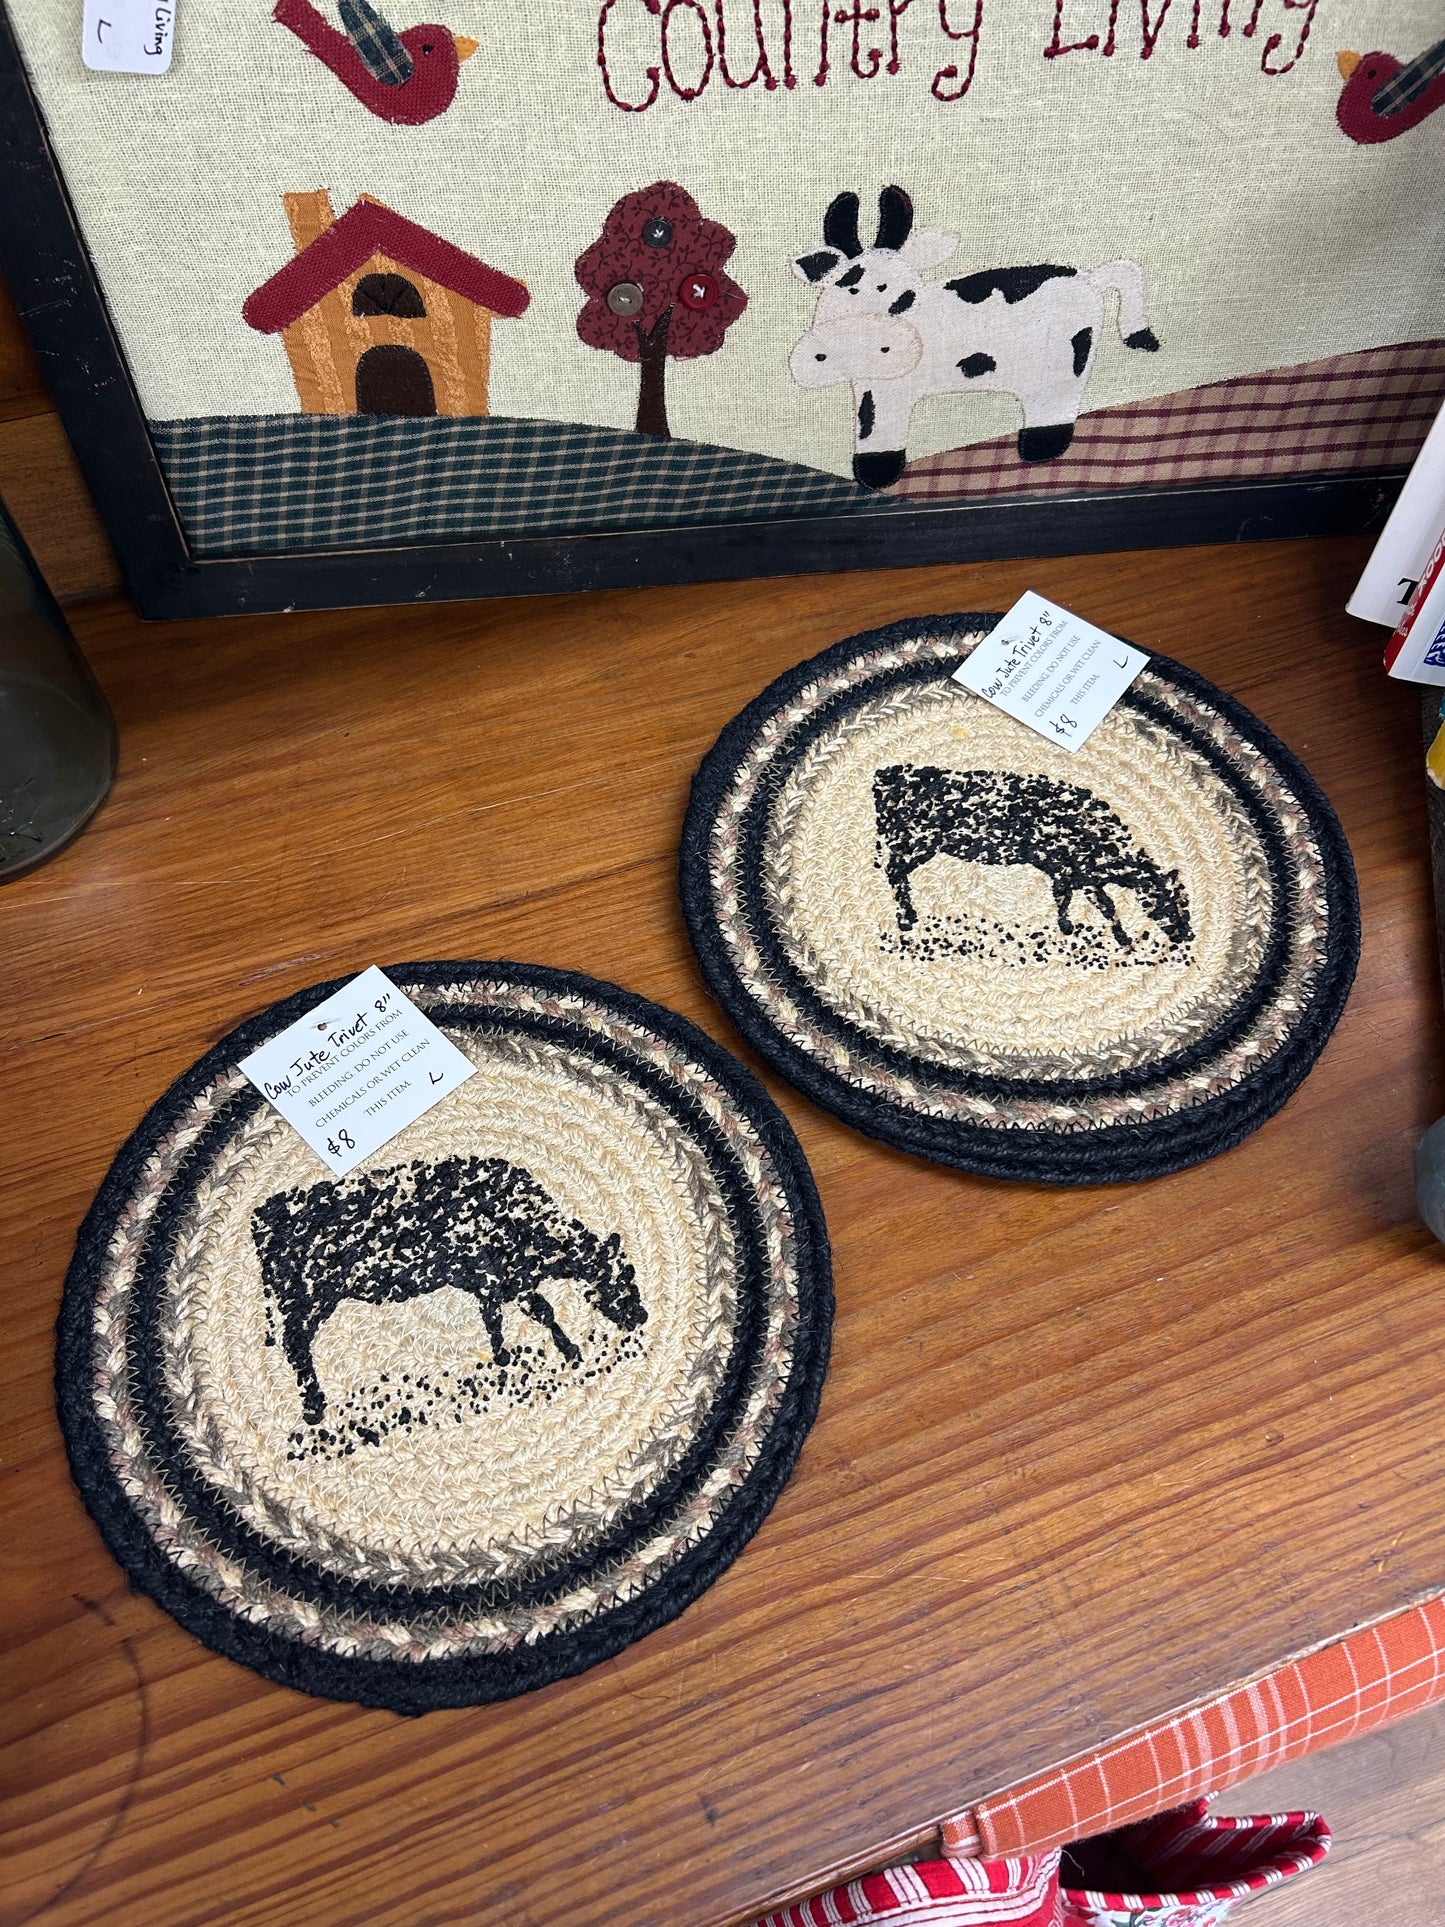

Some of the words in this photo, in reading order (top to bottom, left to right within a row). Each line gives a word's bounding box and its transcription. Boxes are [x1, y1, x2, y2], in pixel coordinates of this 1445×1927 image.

[143, 7, 172, 55] Living
[982, 677, 1003, 699] Cow
[997, 658, 1021, 678] Jute
[1013, 625, 1043, 659] Trivet
[1001, 685, 1012, 697] TO
[1007, 662, 1033, 691] PREVENT
[1029, 638, 1053, 662] COLORS
[1050, 621, 1068, 641] FROM
[1035, 685, 1064, 718] CHEMICALS
[1063, 672, 1074, 686] OR
[1071, 659, 1086, 676] WET
[1082, 639, 1101, 662] CLEAN
[1047, 661, 1059, 674] DO
[1057, 647, 1070, 663] NOT
[1067, 635, 1081, 649] USE
[1071, 690, 1085, 705] THIS
[1049, 713, 1078, 737] $8
[264, 1075, 292, 1100] Cow
[290, 1050, 330, 1077] Jute
[328, 1012, 368, 1047] Trivet
[286, 1084, 301, 1098] TO
[302, 1055, 341, 1088] PREVENT
[341, 1028, 377, 1057] COLORS
[377, 1009, 403, 1031] FROM
[354, 1059, 370, 1072] DO
[369, 1043, 392, 1062] NOT
[391, 1029, 409, 1044] USE
[315, 1087, 367, 1128] CHEMICALS
[366, 1075, 383, 1088] OR
[381, 1061, 401, 1078] WET
[402, 1038, 431, 1062] CLEAN
[363, 1098, 387, 1116] THIS
[328, 1129, 355, 1157] $8
